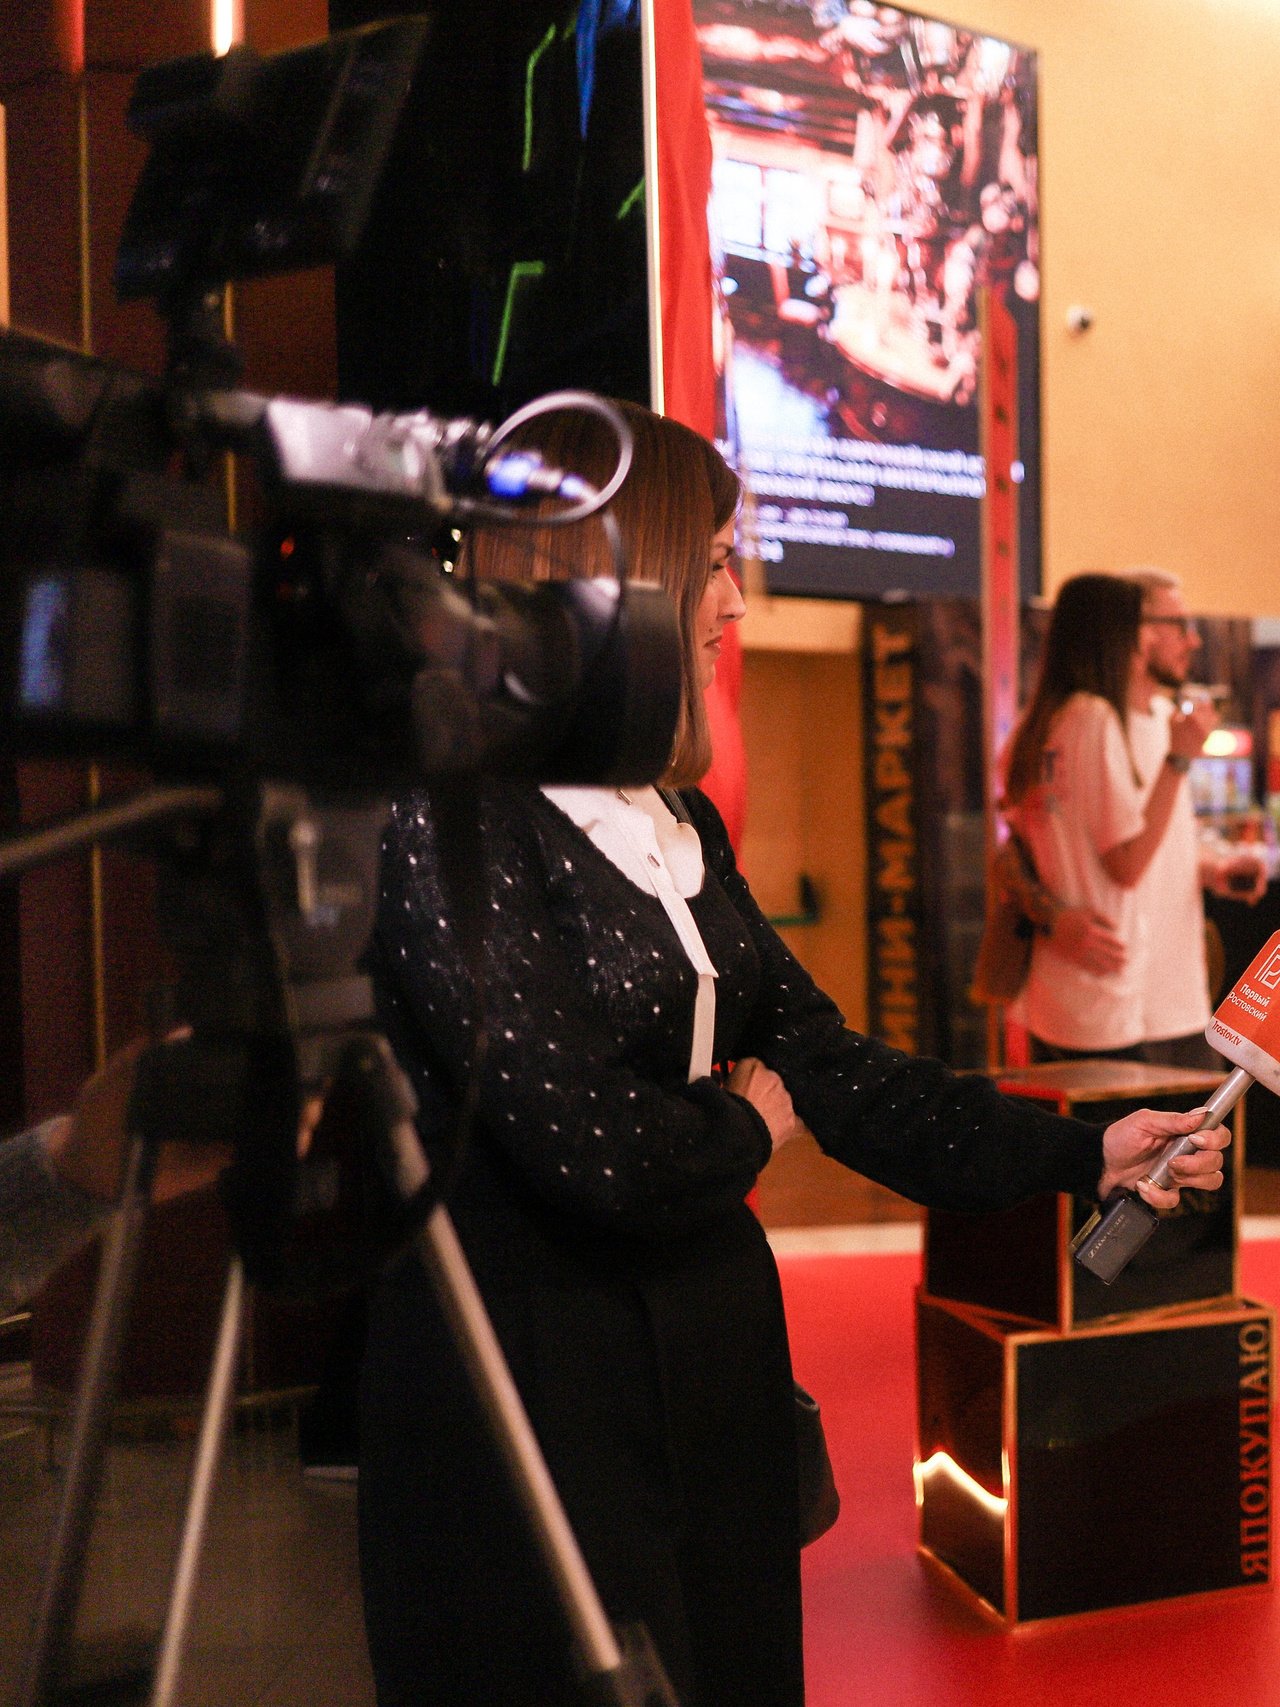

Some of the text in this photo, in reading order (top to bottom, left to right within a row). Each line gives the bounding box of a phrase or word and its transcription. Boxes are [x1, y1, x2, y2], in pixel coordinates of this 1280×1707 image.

[873, 624, 916, 1057] ИНИ-МАРКЕТ
[1227, 992, 1268, 1021] Ростовский
[1240, 984, 1271, 1007] Первый
